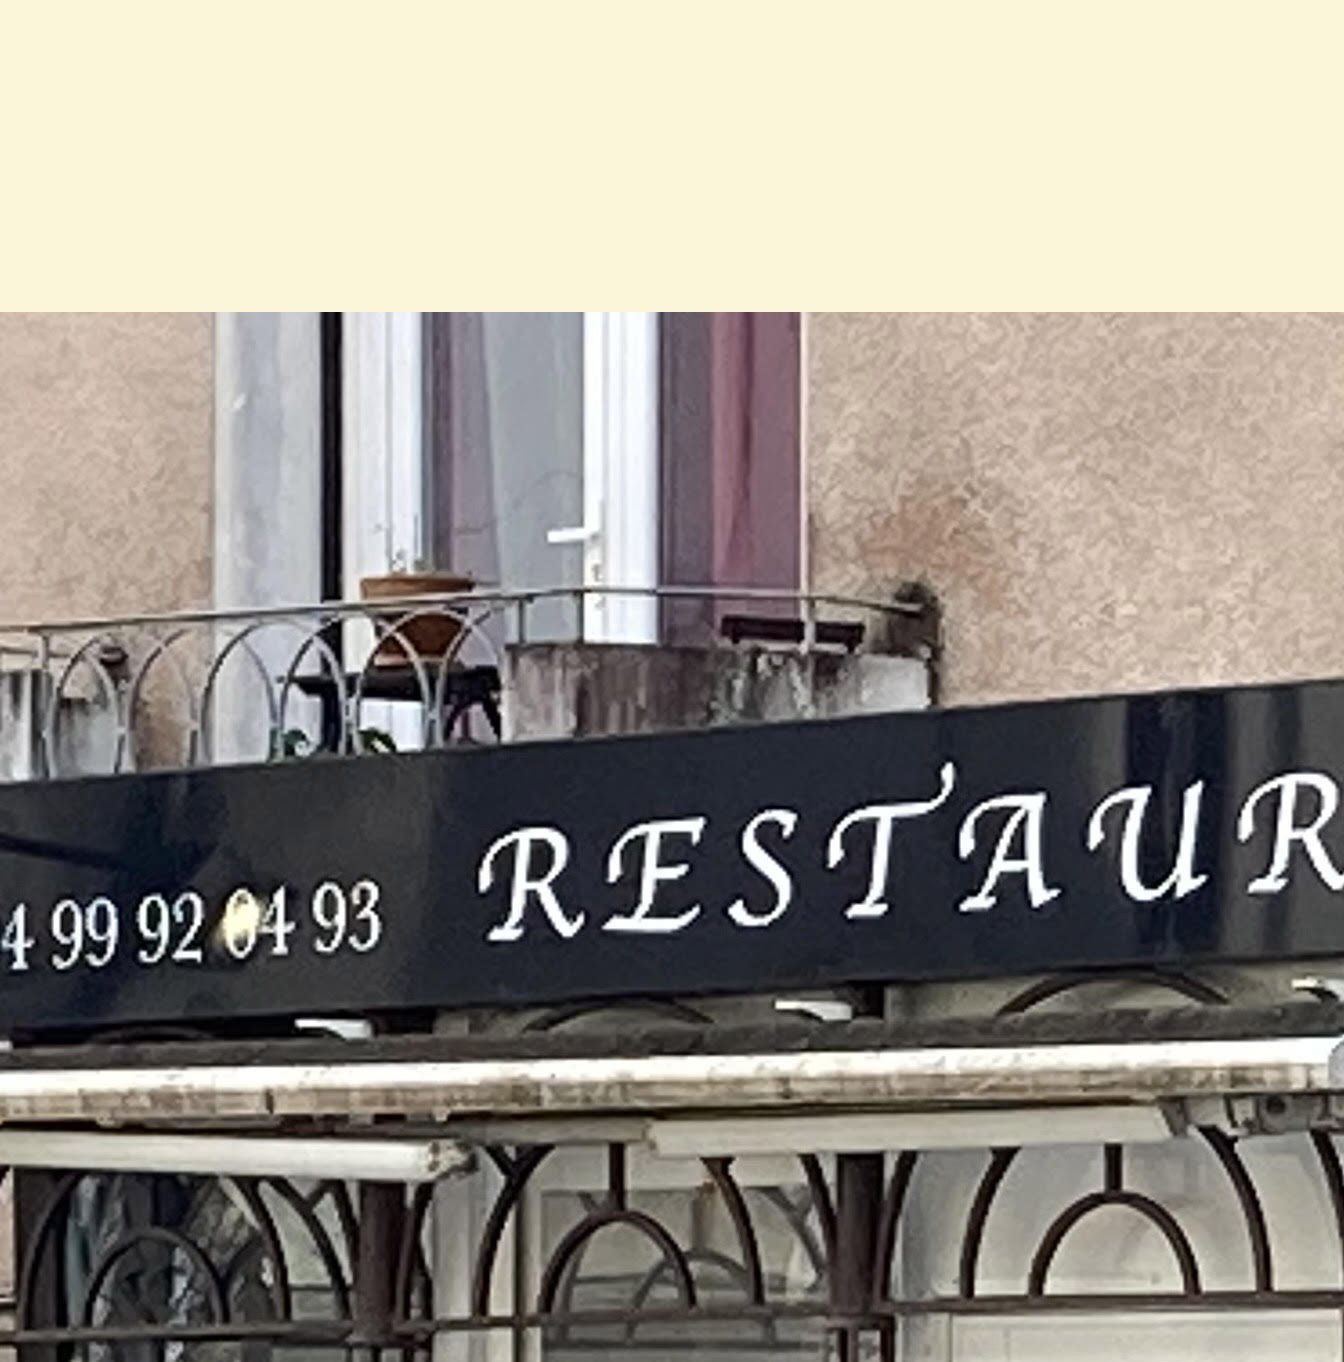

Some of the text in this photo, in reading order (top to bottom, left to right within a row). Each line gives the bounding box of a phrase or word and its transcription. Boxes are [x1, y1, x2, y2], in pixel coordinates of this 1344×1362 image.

[51, 896, 119, 971] 99
[136, 891, 204, 964] 92
[221, 885, 296, 960] 04
[312, 879, 382, 954] 93
